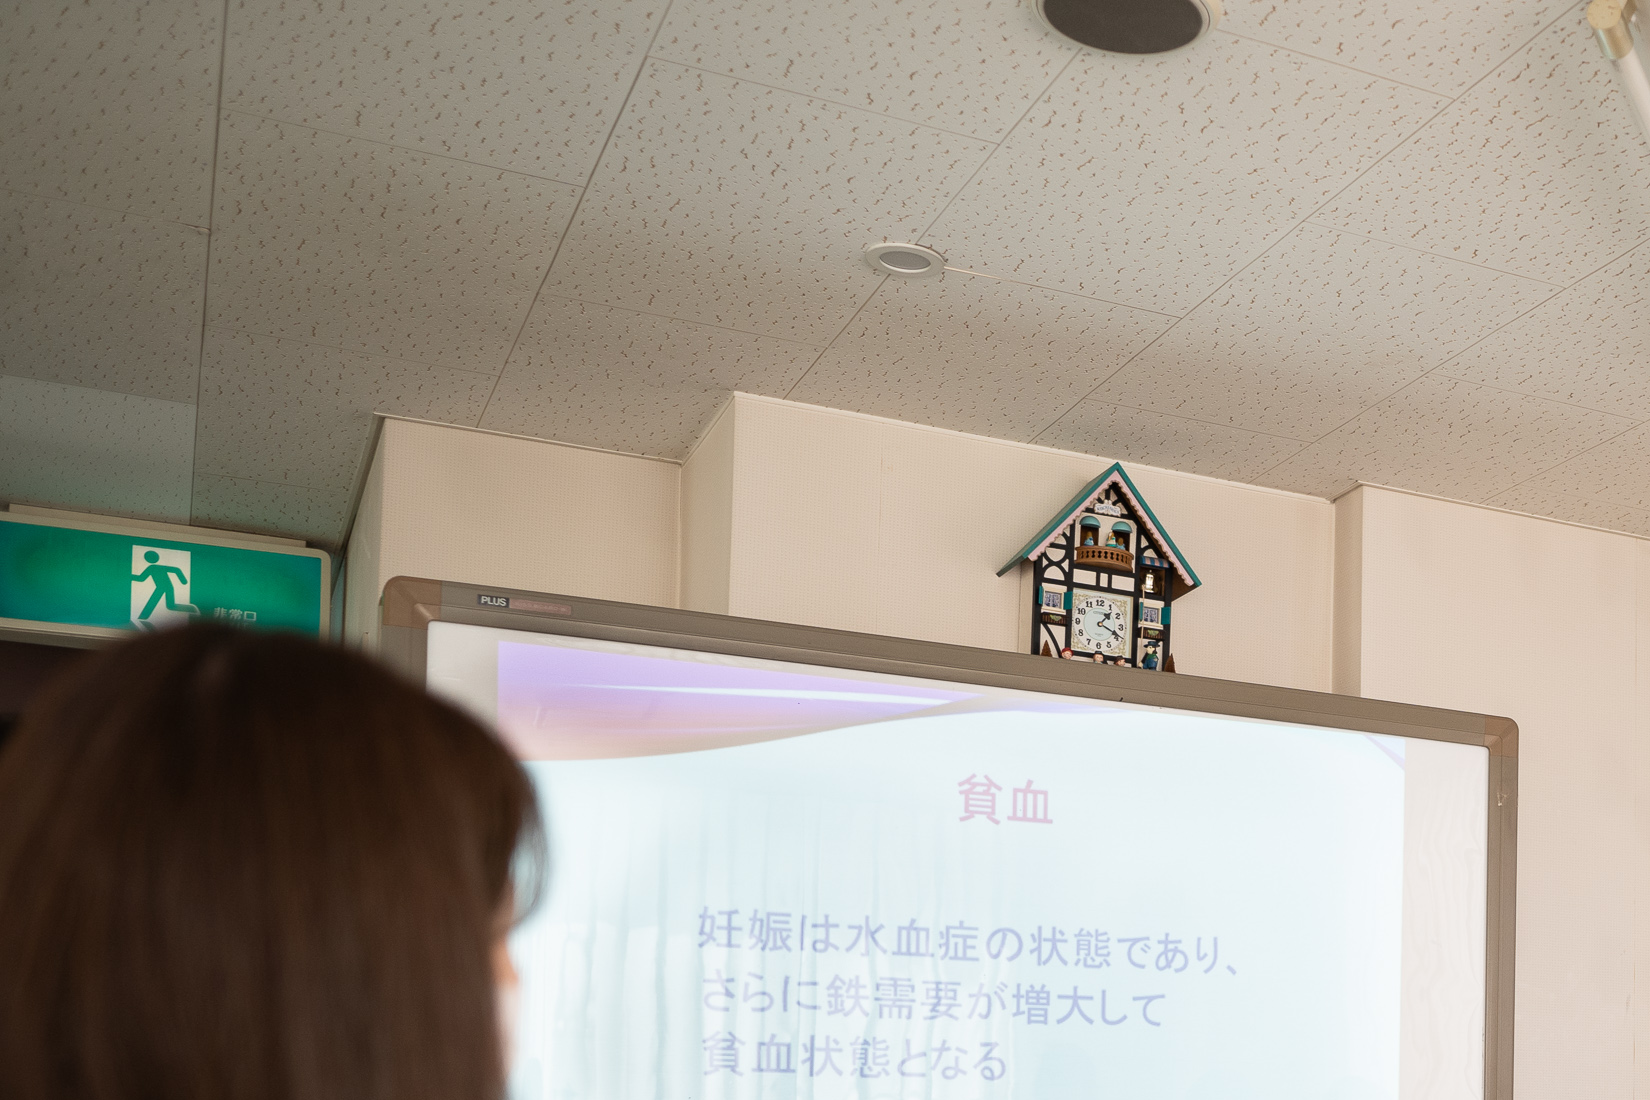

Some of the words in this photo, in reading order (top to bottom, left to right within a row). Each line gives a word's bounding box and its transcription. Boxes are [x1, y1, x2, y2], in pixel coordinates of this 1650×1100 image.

[213, 606, 257, 621] 非常口
[481, 595, 507, 607] PLUS
[958, 773, 1053, 825] 貧血
[698, 905, 1237, 976] 妊娠は水血症の状態であり、
[702, 968, 1166, 1027] さらに鉄需要が増大して
[702, 1031, 1006, 1082] 貧血状態となる
